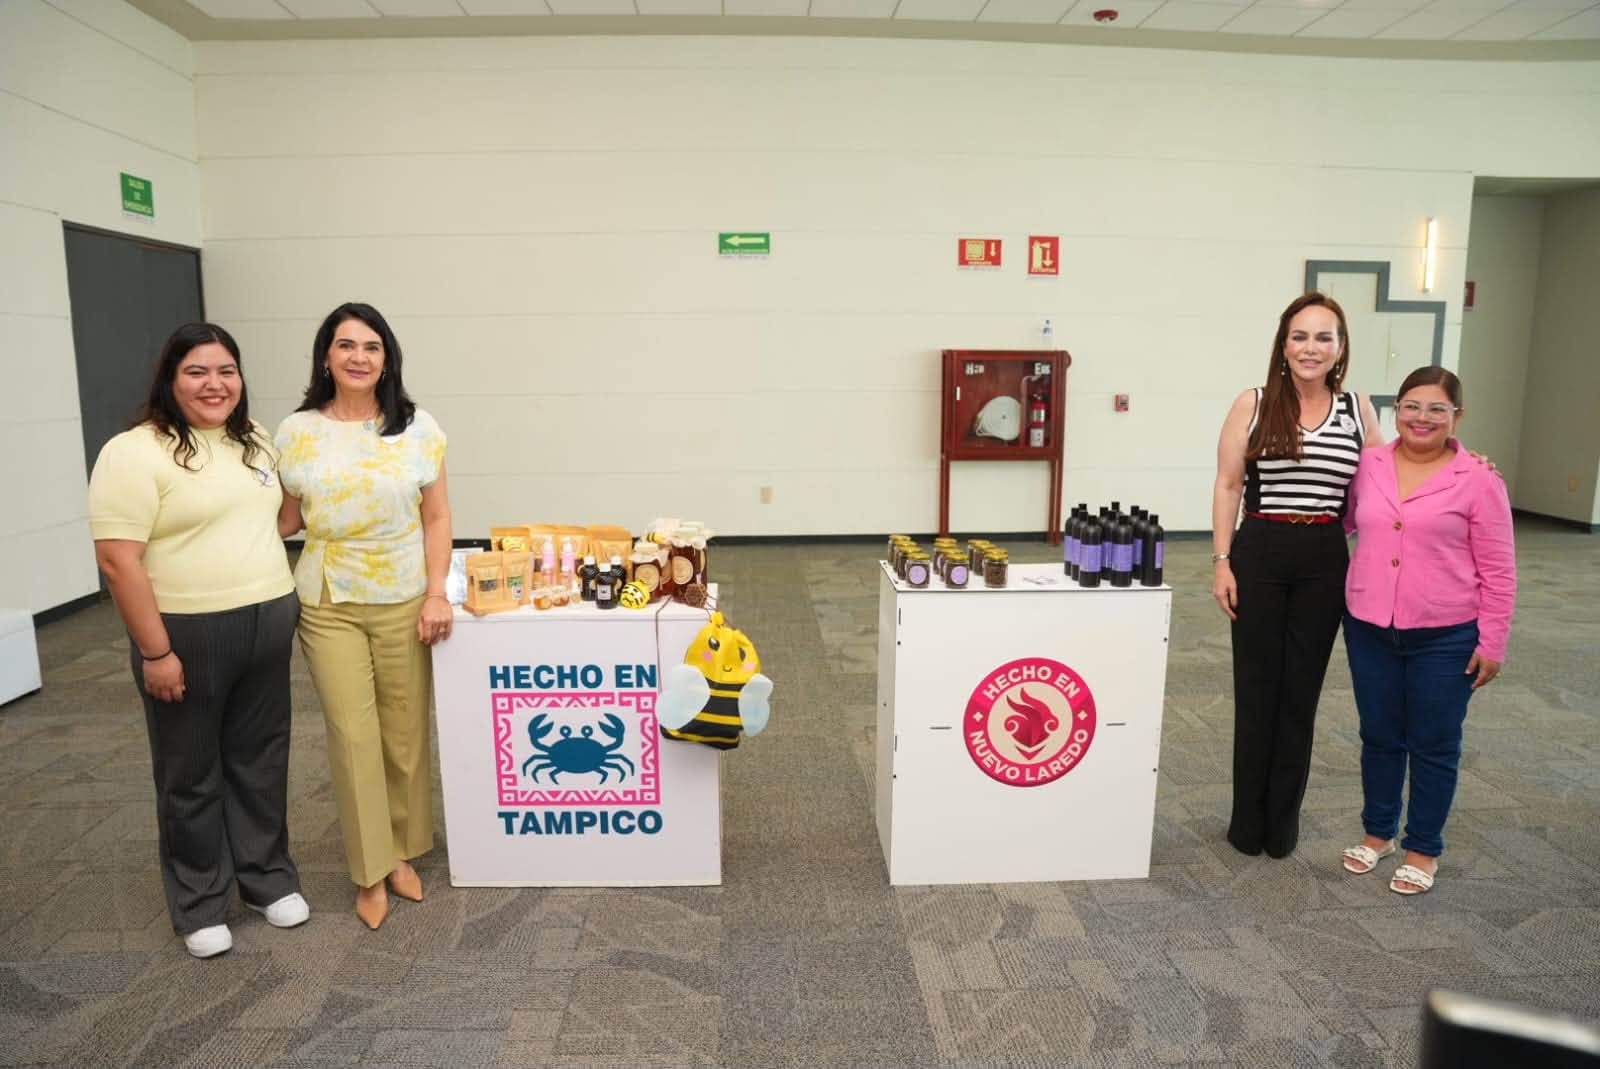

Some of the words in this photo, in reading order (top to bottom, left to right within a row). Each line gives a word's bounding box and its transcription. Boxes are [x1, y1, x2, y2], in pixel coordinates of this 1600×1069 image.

[489, 665, 603, 690] HECHO
[615, 664, 657, 689] EN
[982, 664, 1053, 701] HECHO
[1053, 672, 1081, 699] EN
[969, 730, 1021, 781] NUEVO
[1024, 728, 1089, 782] LAREDO
[498, 810, 664, 835] TAMPICO
